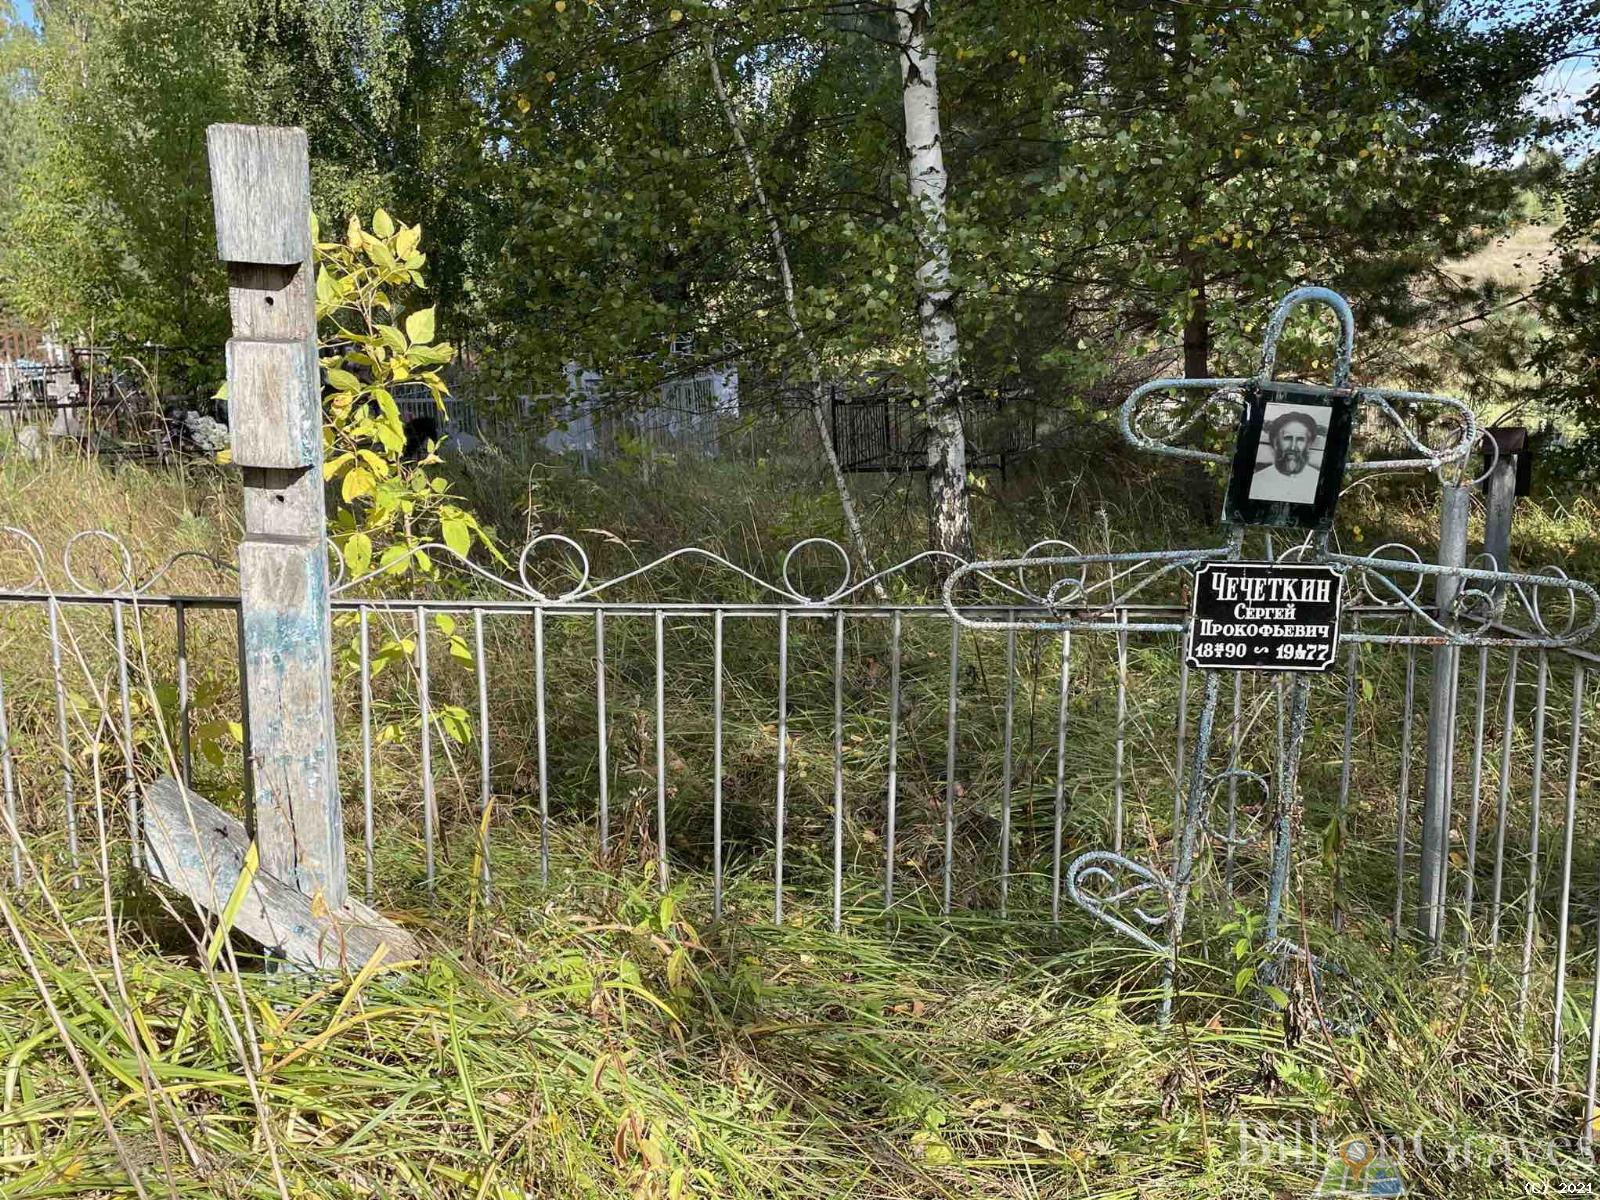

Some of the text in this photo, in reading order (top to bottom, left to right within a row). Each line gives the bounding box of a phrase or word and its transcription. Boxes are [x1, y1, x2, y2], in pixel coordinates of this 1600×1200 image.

[1212, 572, 1331, 603] ЧЕЧЕТКИН
[1234, 603, 1296, 620] СЕРГЕЙ
[1200, 619, 1330, 638] ПРОКОФЬЕВИЧ
